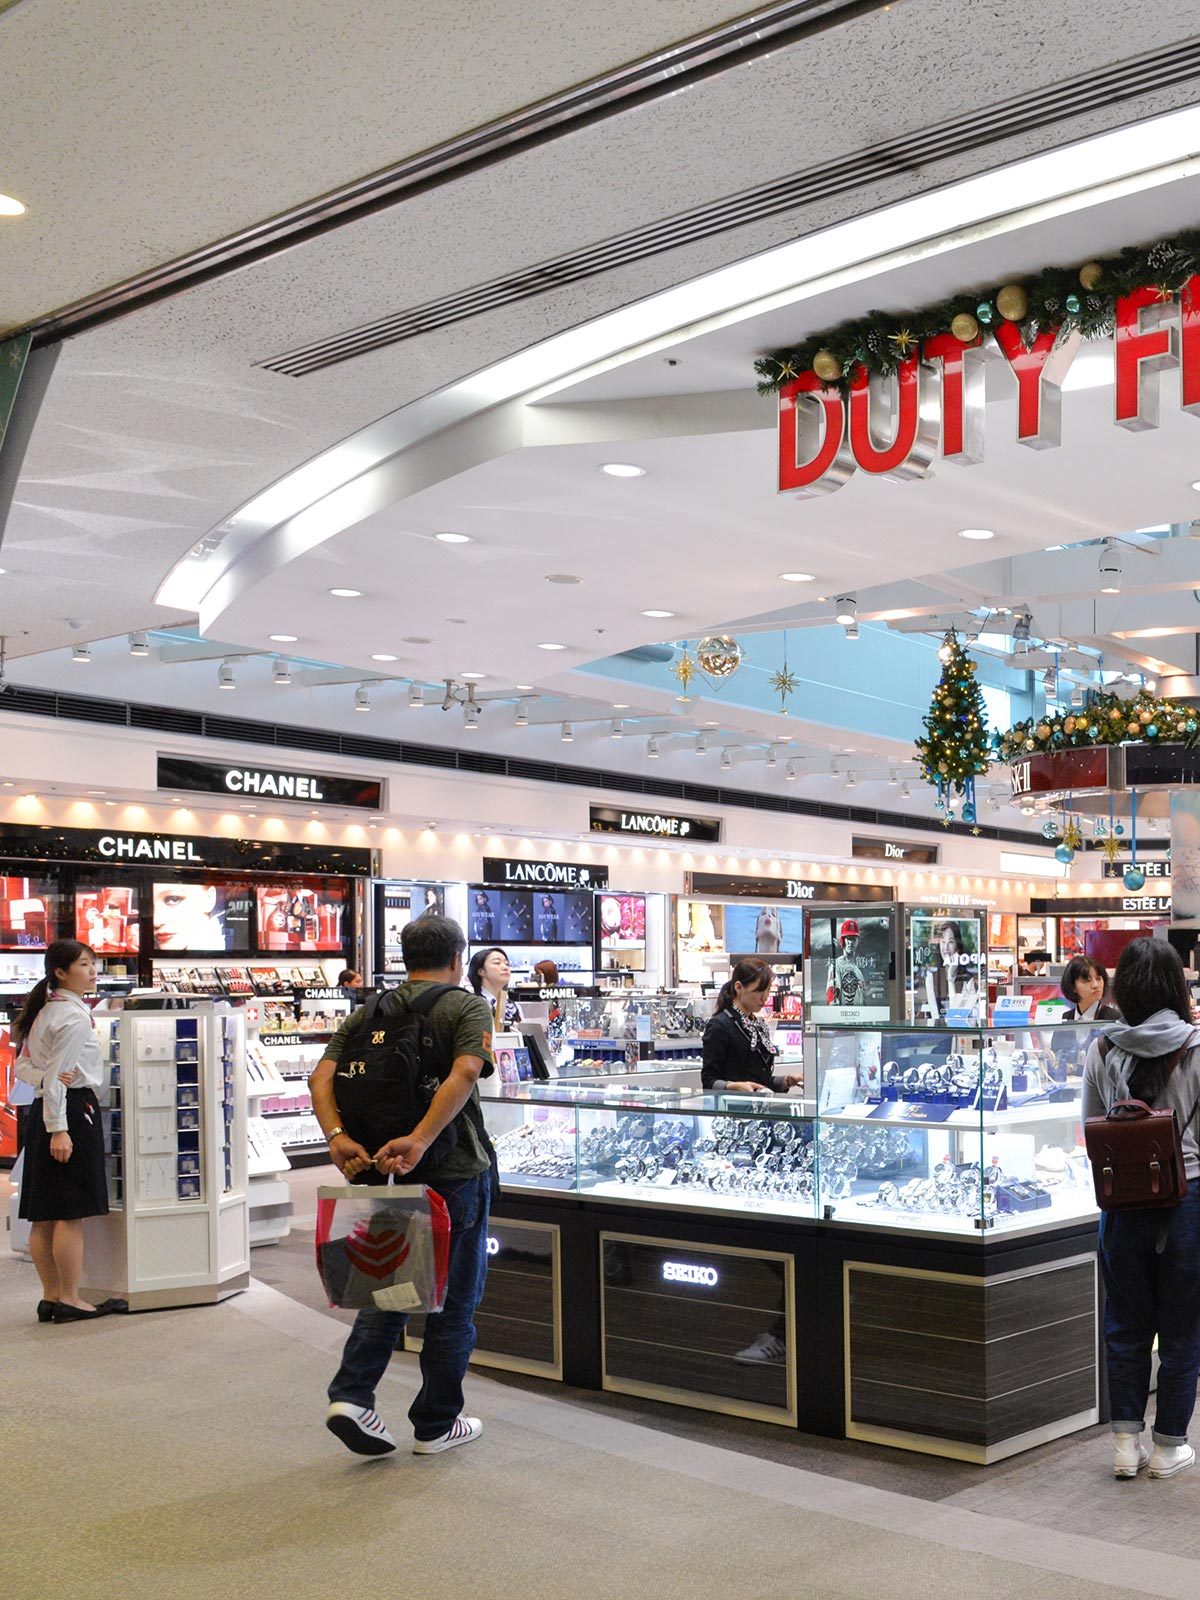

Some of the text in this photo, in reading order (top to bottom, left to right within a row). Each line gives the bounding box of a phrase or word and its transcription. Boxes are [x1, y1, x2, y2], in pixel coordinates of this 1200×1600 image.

[777, 318, 1075, 500] DUTY
[225, 770, 323, 799] CHANEL
[621, 815, 678, 834] LANCÔME
[98, 836, 203, 861] CHANEL
[885, 844, 905, 858] Dior
[505, 863, 577, 883] LANCÔME
[786, 881, 814, 899] Dior
[1123, 897, 1157, 910] ESTÉE
[305, 988, 344, 999] CHANEL
[539, 988, 577, 999] CHANEL
[264, 1034, 302, 1045] CHANEL
[663, 1260, 718, 1287] SEIKO
